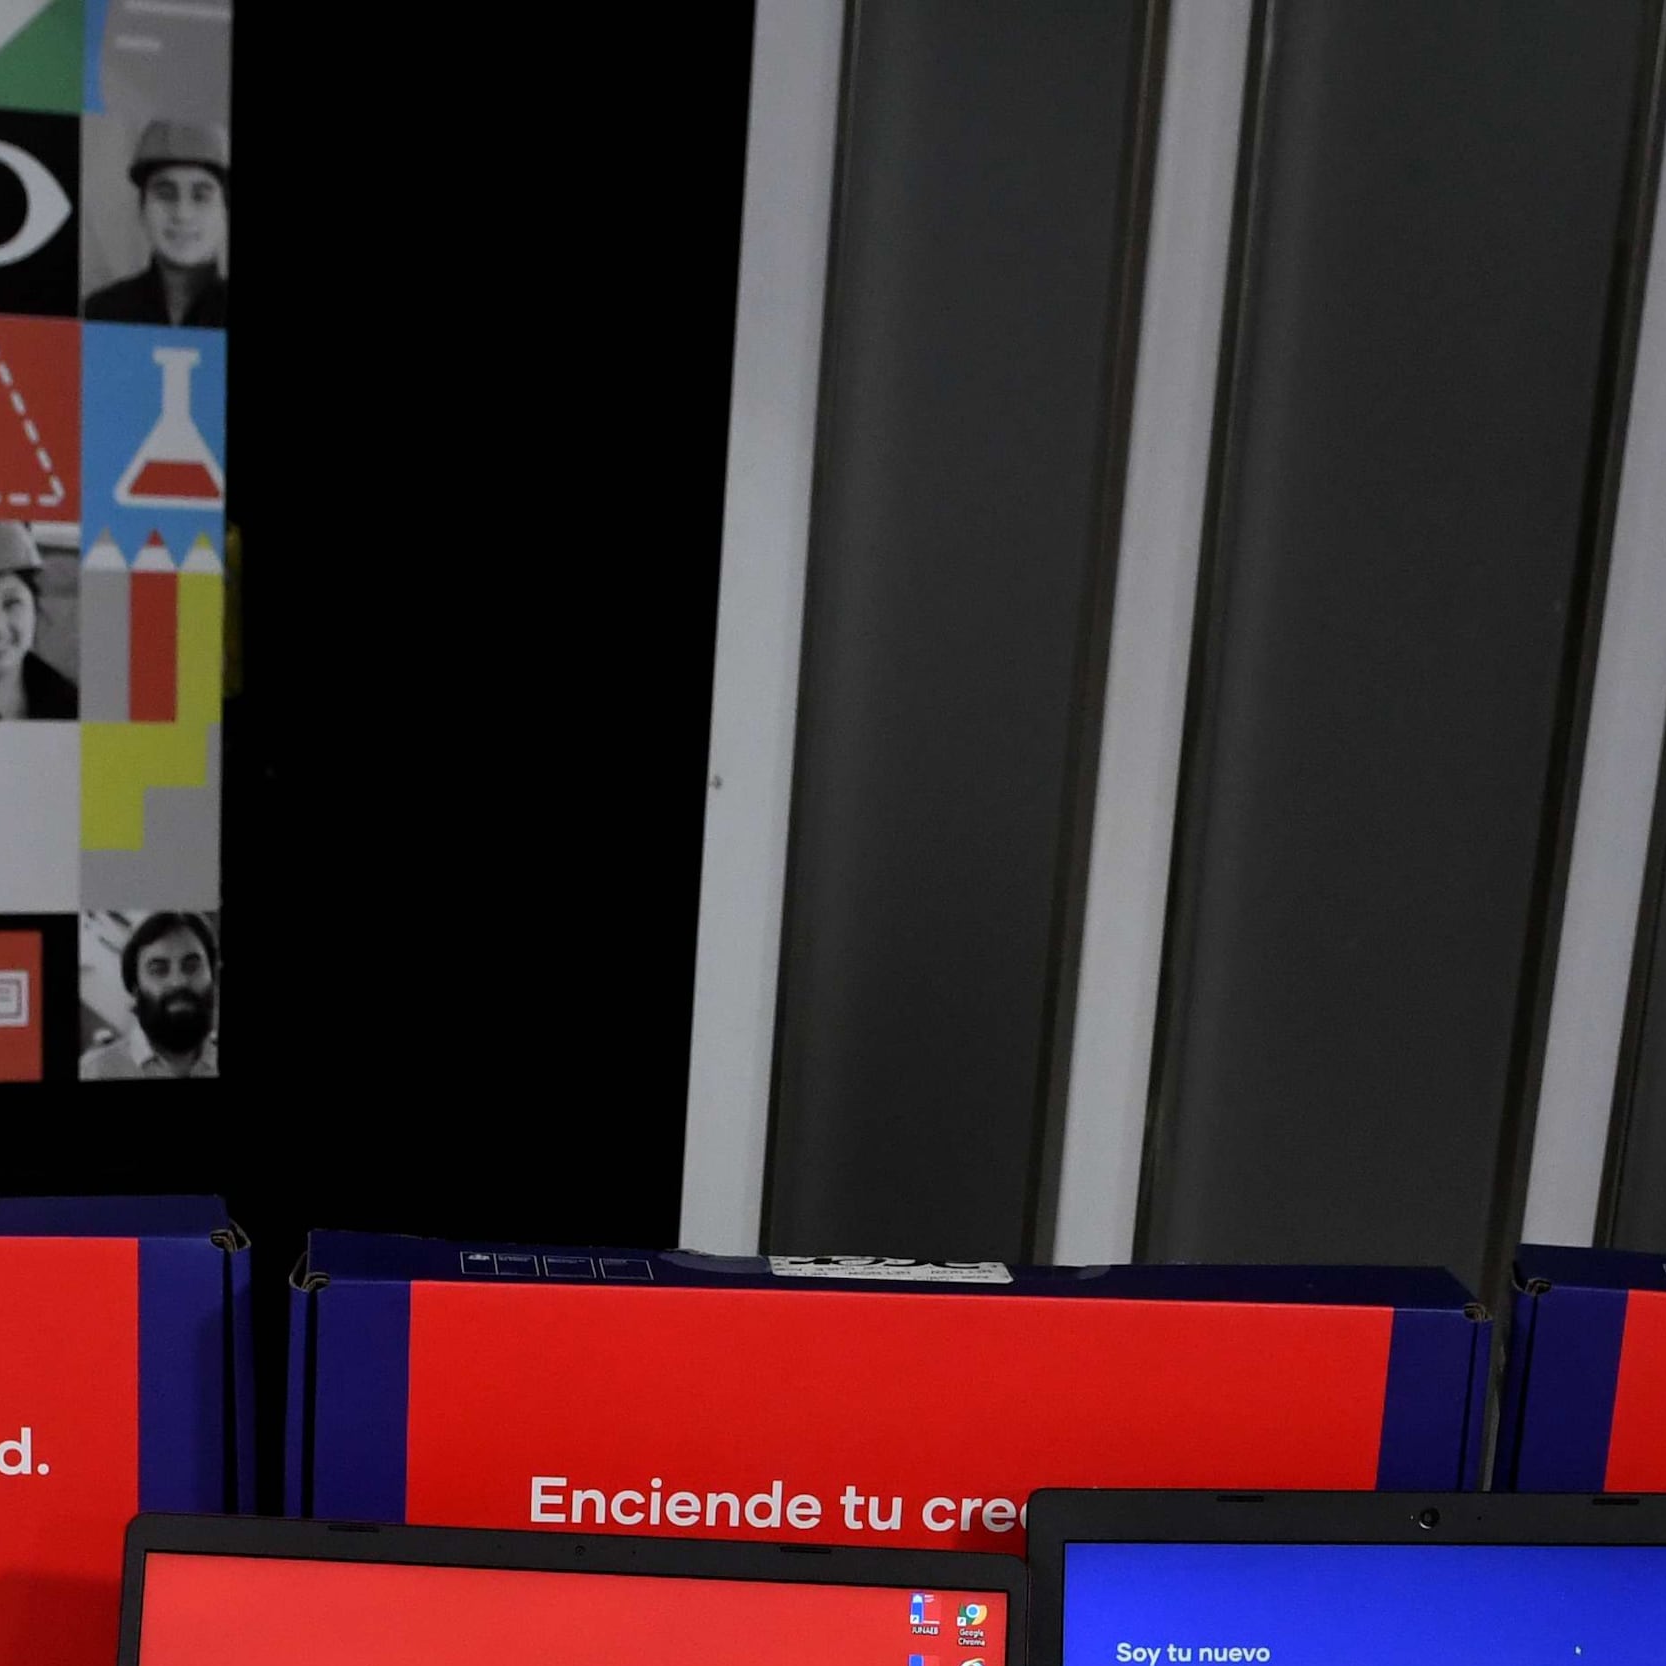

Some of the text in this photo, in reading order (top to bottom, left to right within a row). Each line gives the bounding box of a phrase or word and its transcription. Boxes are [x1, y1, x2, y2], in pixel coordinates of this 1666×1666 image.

[531, 1476, 1028, 1533] Enciende tu cre
[960, 1629, 984, 1638] Google
[958, 1638, 985, 1646] Chrome
[1116, 1642, 1271, 1666] Soy tu nuevo
